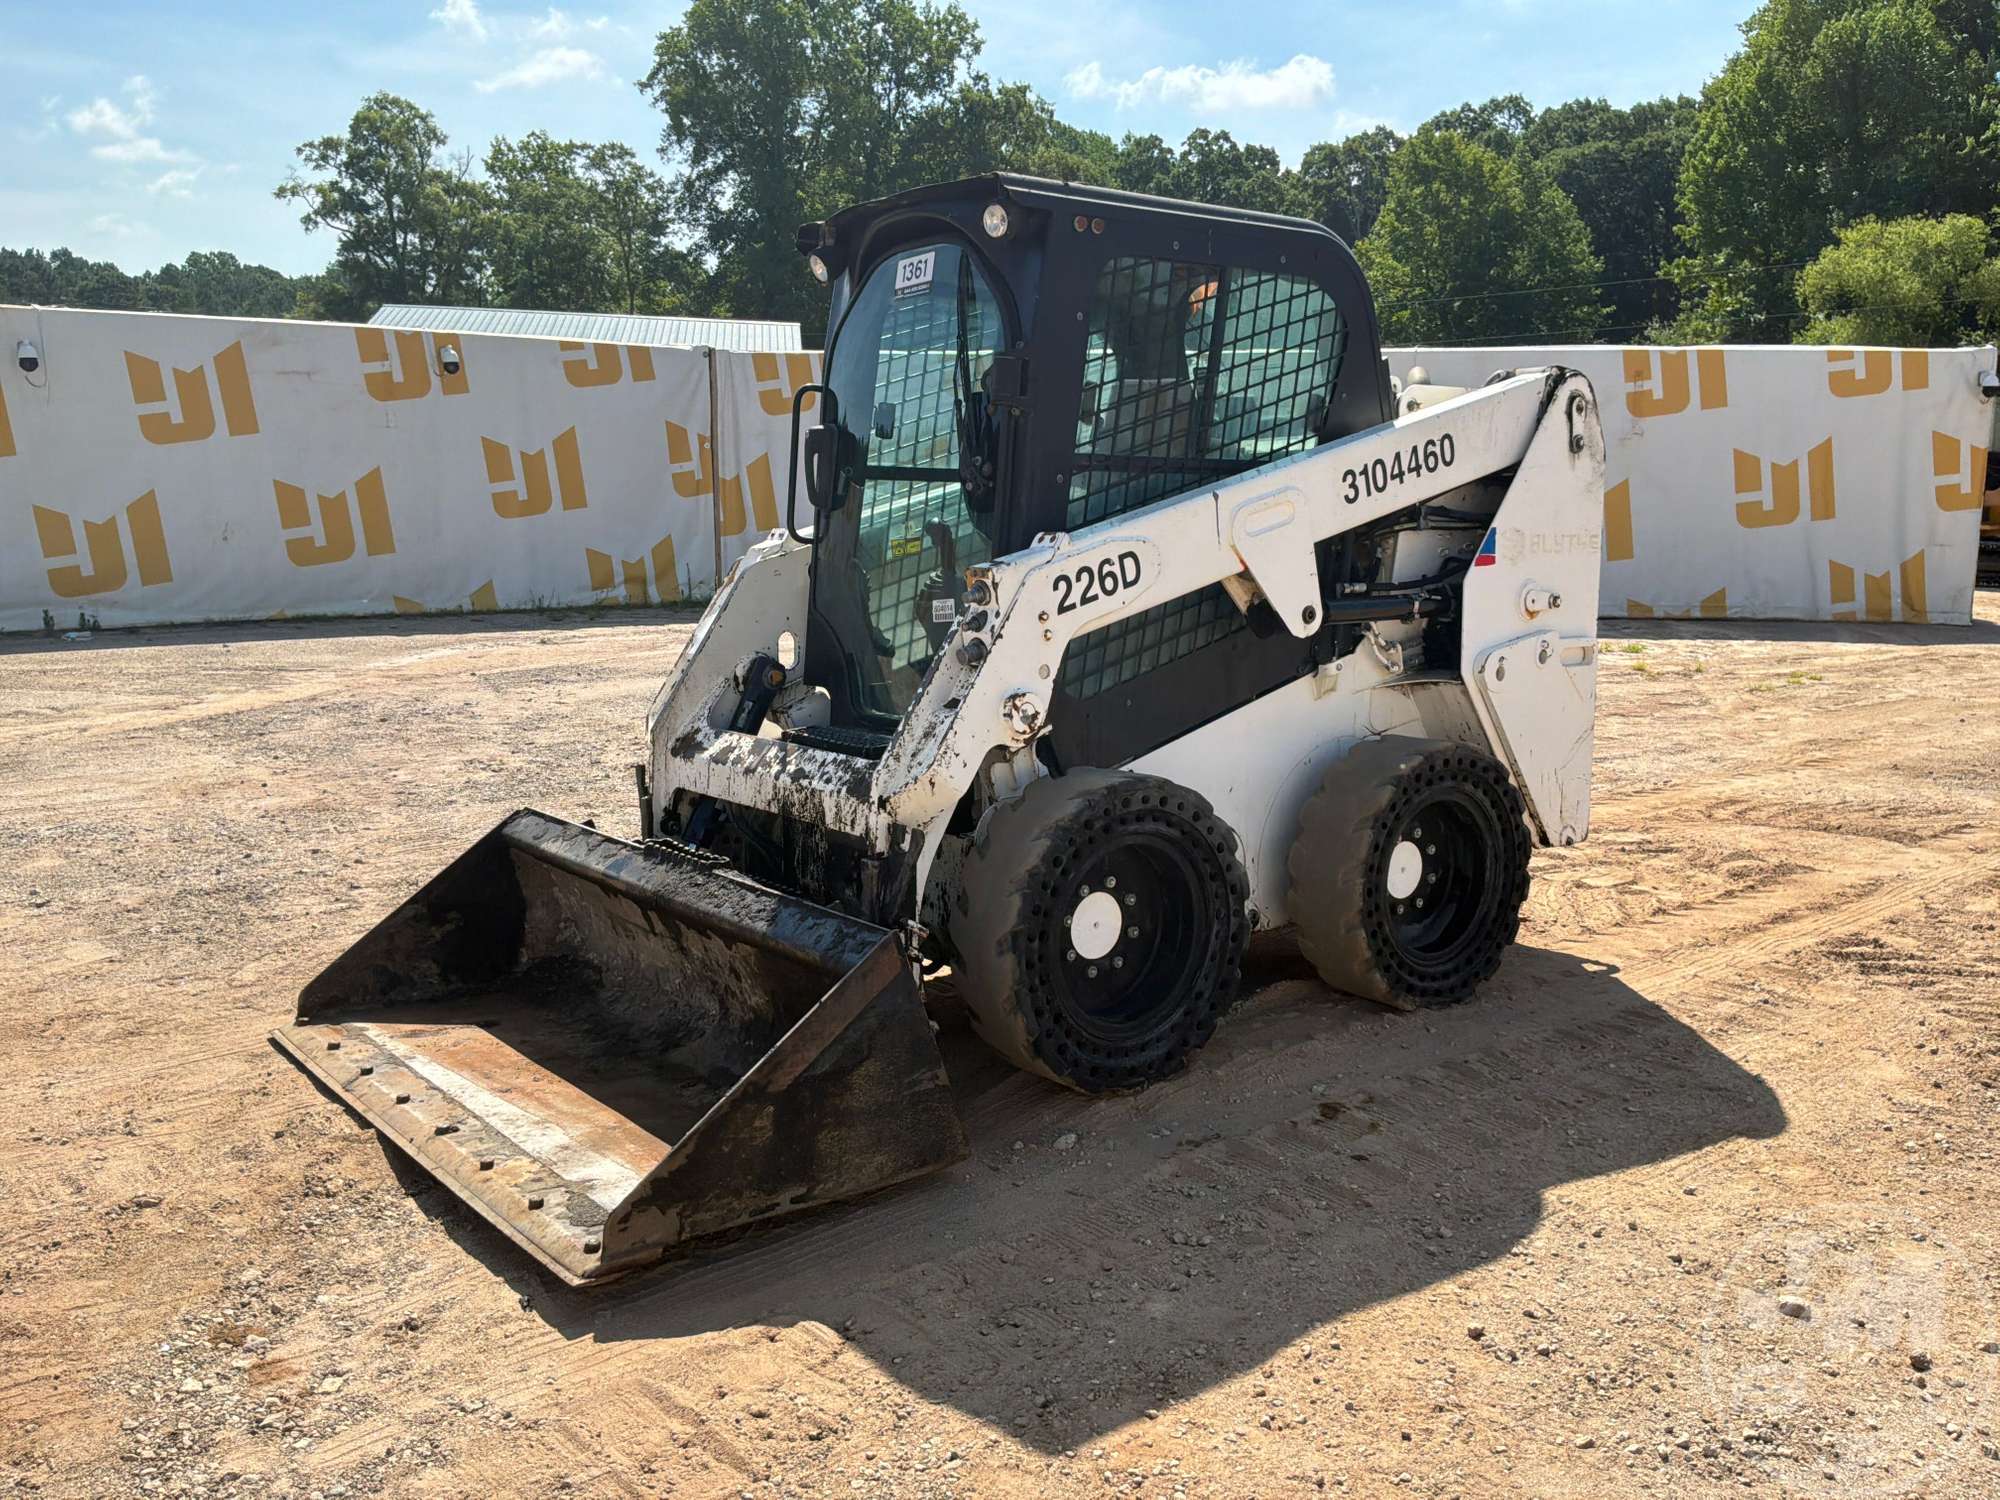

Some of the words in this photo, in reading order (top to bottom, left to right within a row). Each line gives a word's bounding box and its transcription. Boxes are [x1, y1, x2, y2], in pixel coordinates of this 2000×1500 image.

[902, 258, 929, 283] 1361
[1342, 433, 1455, 504] 3104460
[1052, 550, 1142, 615] 226D
